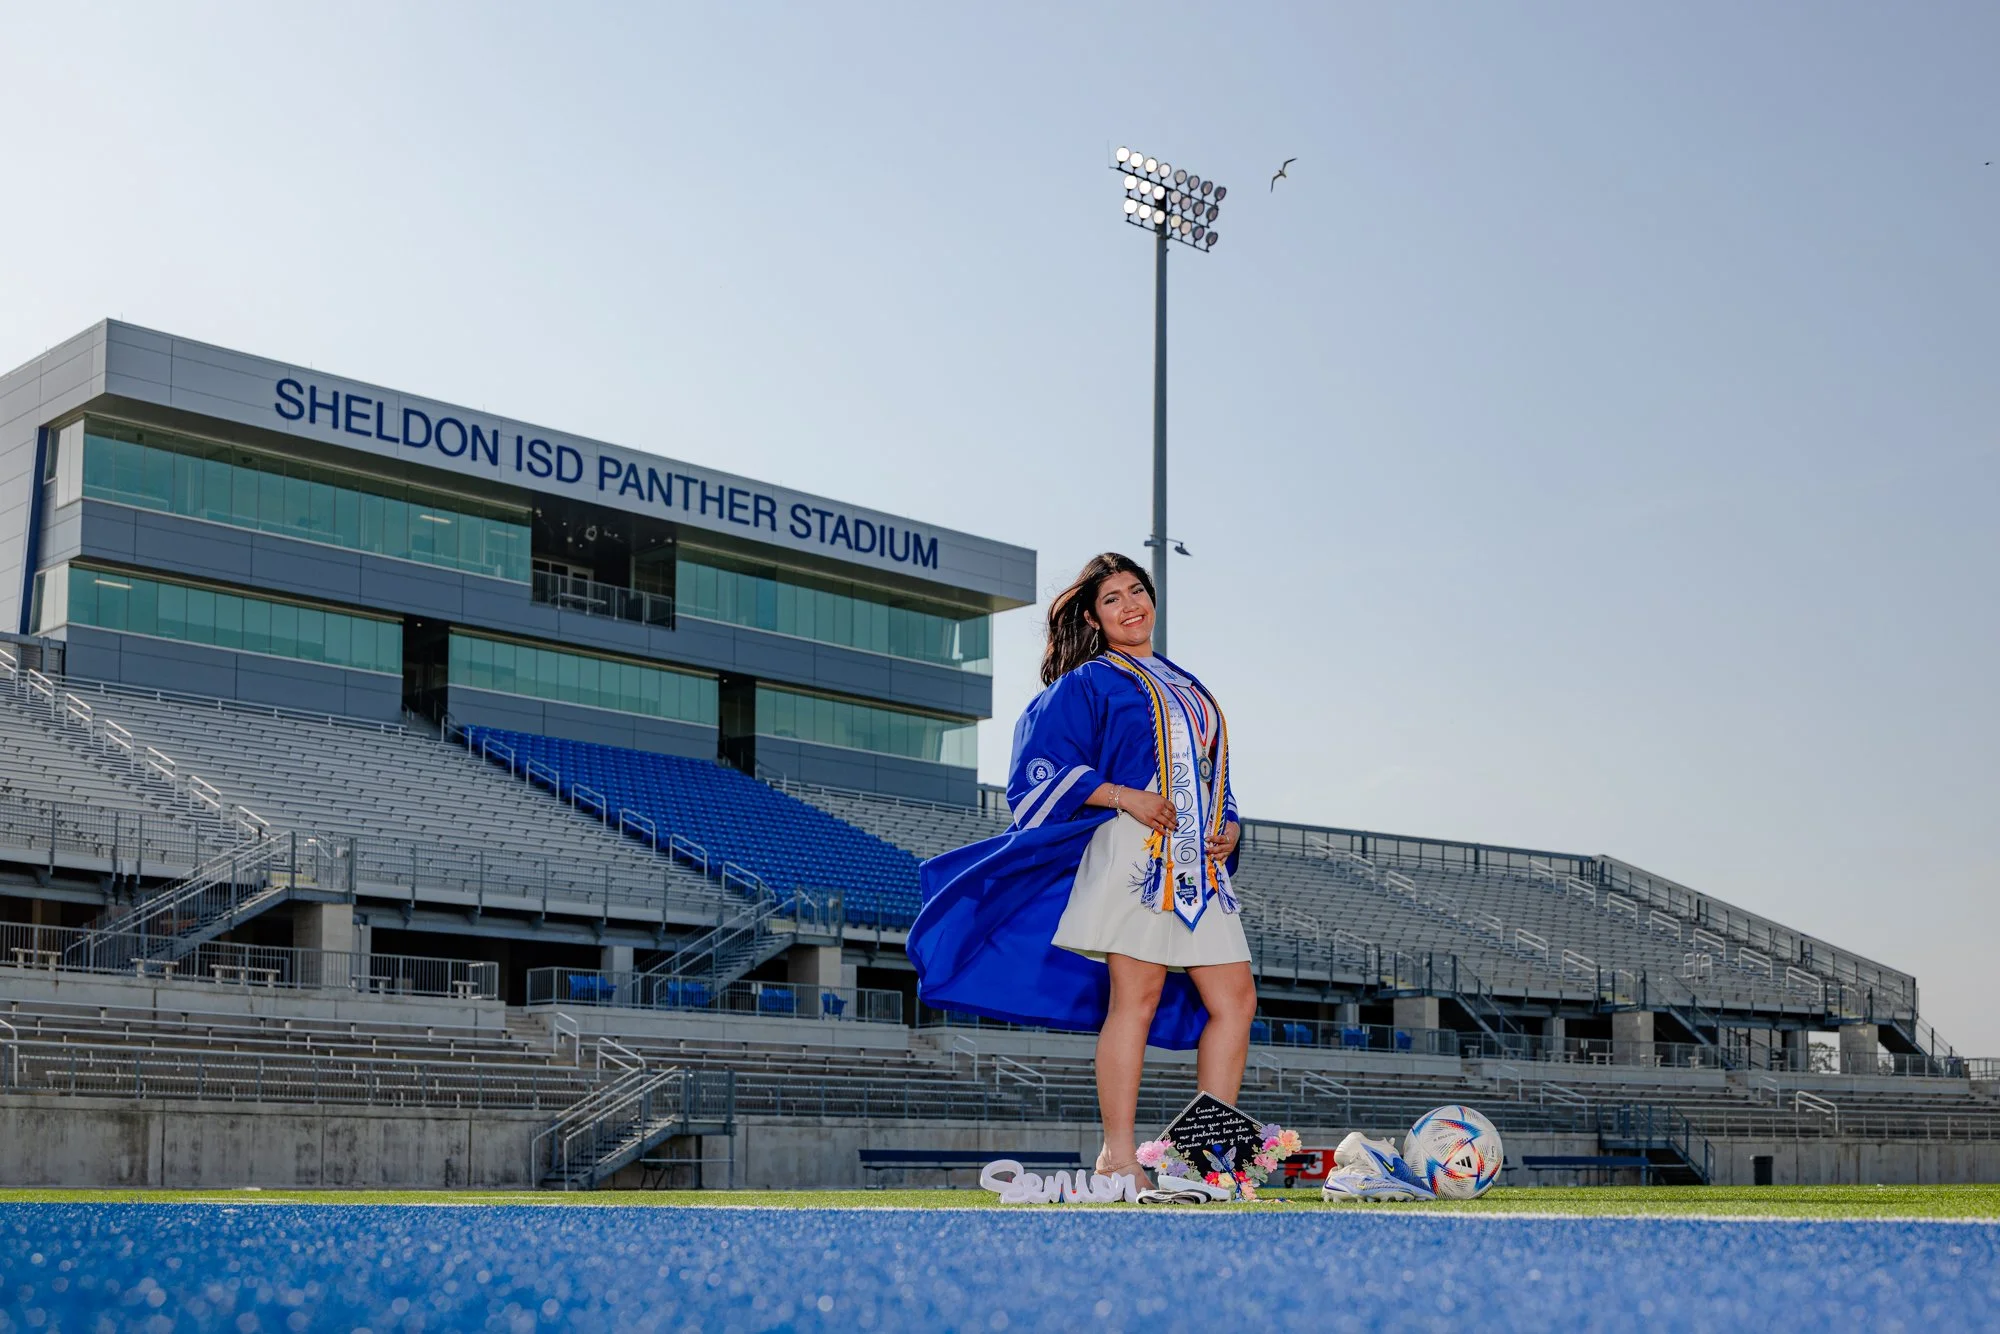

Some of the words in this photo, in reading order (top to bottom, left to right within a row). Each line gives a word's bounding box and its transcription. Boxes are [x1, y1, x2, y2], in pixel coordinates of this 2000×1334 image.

[274, 378, 499, 466] SHELDON
[516, 435, 583, 484] ISD
[598, 456, 777, 532] PANTHER
[789, 503, 938, 570] STADIUM
[1172, 762, 1198, 865] 2026
[1176, 1142, 1202, 1150] Gracias
[1229, 1138, 1236, 1146] y
[1207, 1122, 1220, 1131] que
